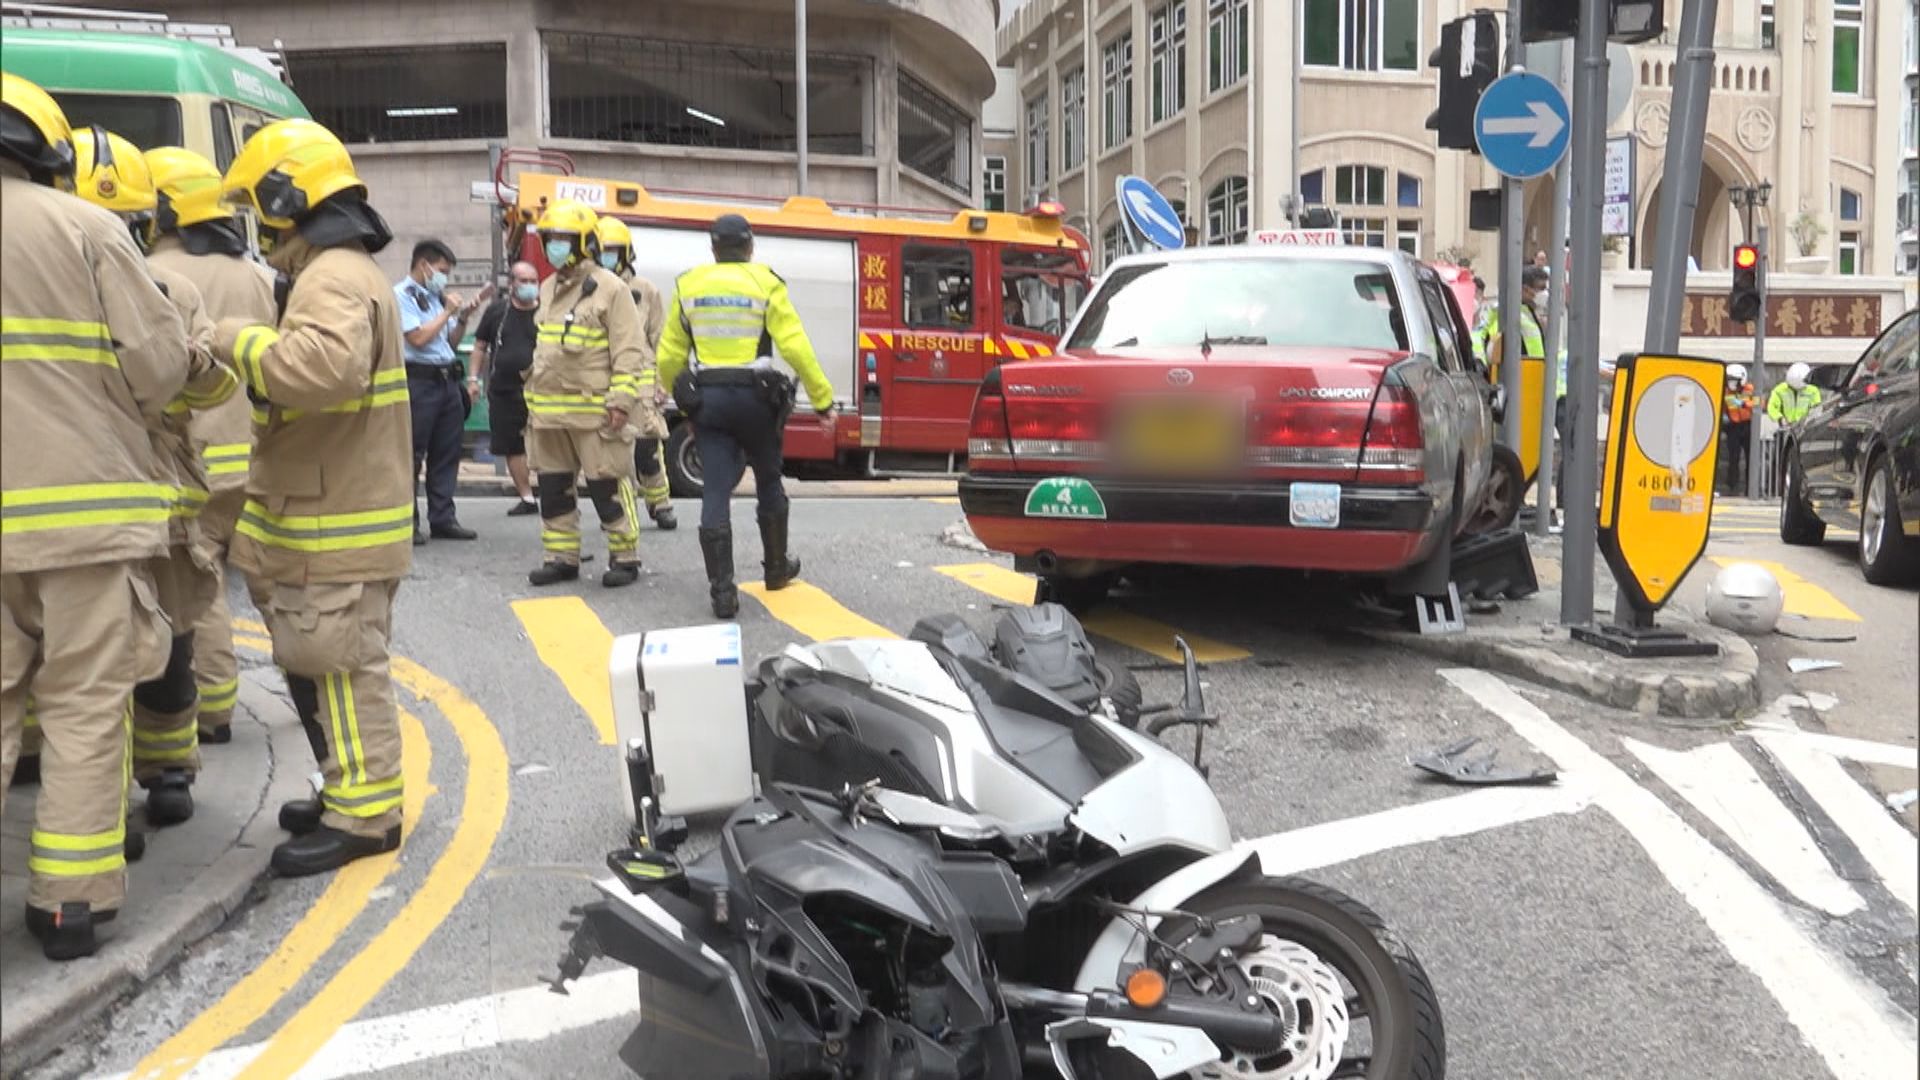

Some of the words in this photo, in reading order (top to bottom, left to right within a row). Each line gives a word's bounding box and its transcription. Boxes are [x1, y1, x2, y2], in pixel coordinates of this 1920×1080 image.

[1258, 230, 1335, 246] TAXI
[862, 253, 888, 312] 救援
[1680, 296, 1874, 336] 賢香港堂
[901, 334, 976, 353] RESCUE
[1056, 486, 1073, 506] 4
